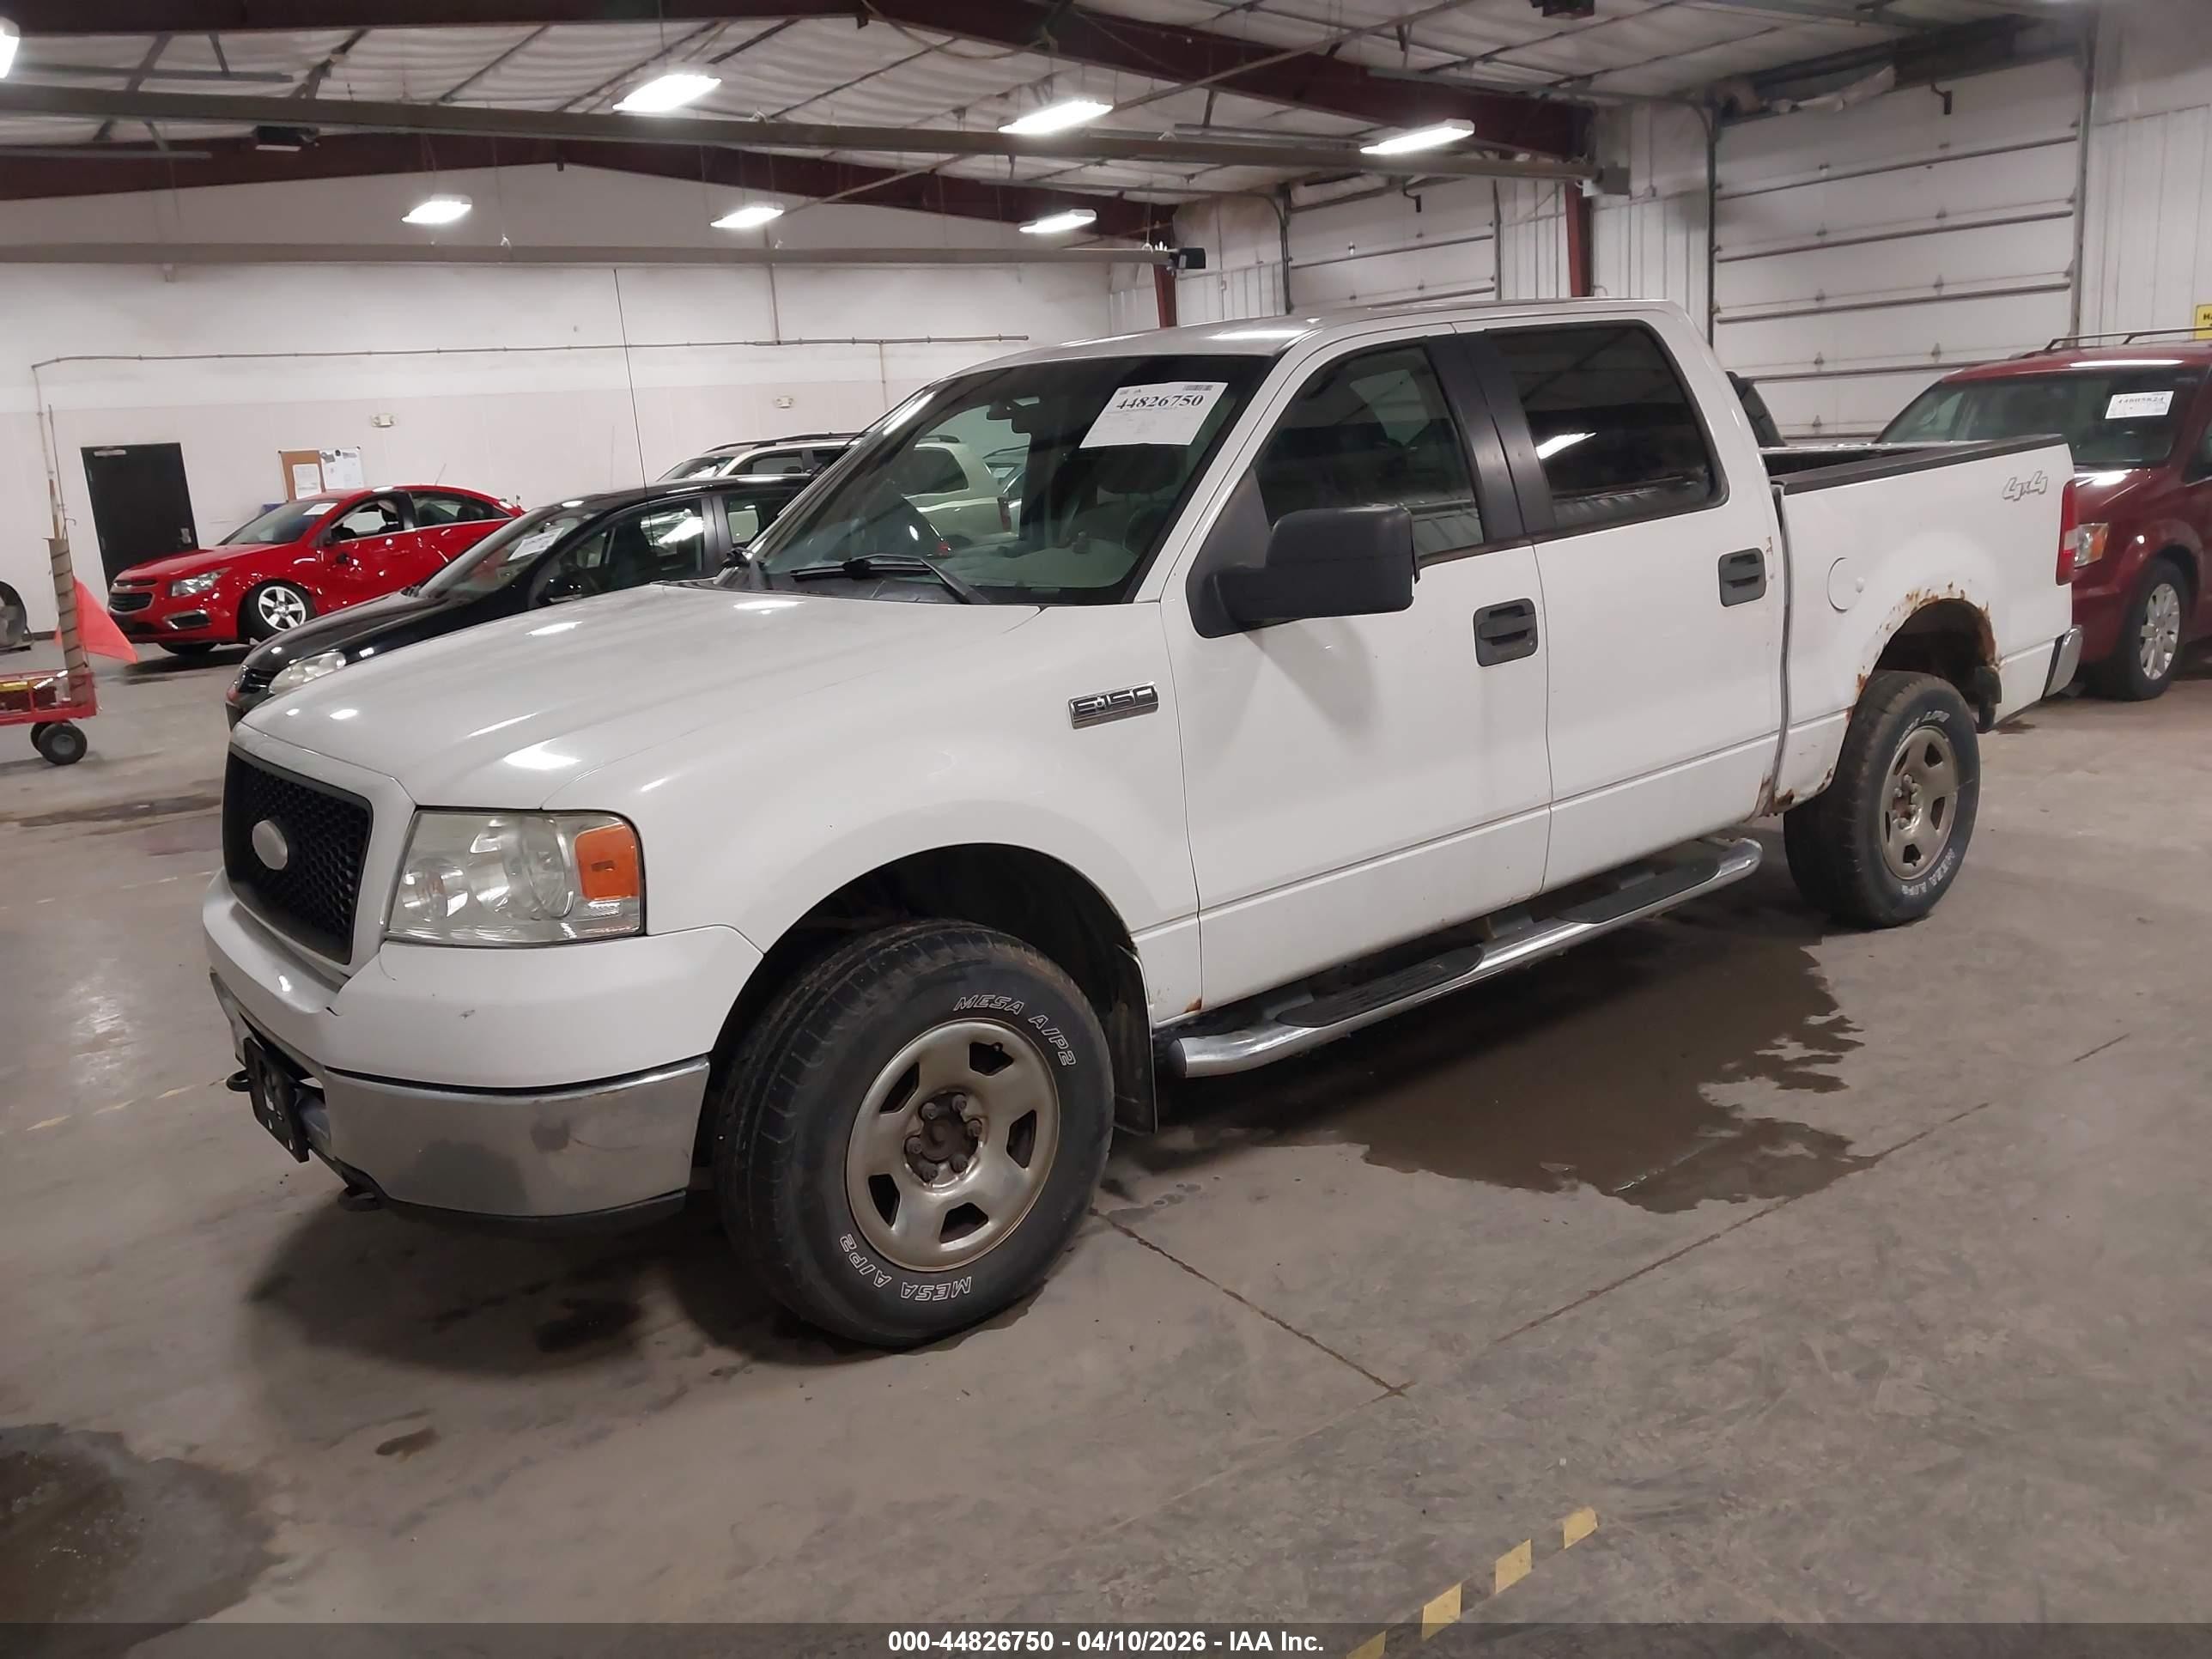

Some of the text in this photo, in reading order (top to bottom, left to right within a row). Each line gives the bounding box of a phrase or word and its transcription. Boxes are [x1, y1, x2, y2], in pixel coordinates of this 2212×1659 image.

[1116, 394, 1205, 410] 44826750
[952, 994, 1024, 1016] MESA
[900, 1276, 972, 1302] MESA
